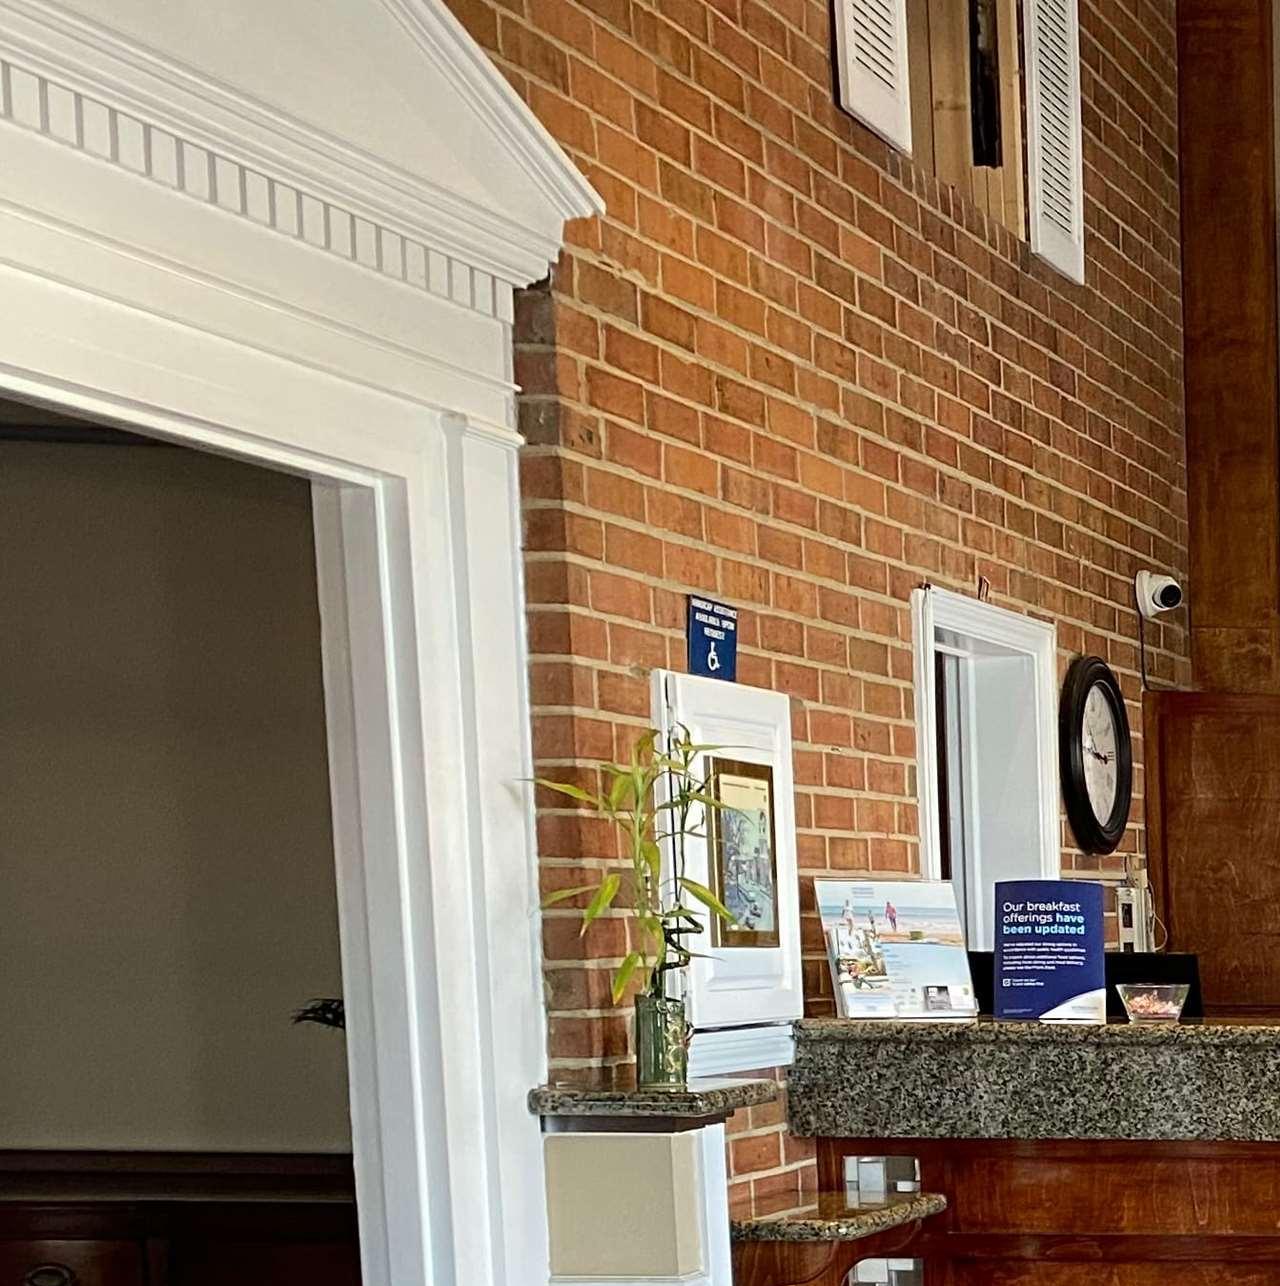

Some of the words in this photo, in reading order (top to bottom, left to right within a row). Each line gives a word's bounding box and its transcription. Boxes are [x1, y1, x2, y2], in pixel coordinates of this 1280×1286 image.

[1003, 902, 1024, 912] Our
[1026, 901, 1081, 912] breakfast
[1003, 913, 1053, 924] offerings
[1055, 912, 1085, 923] have
[1003, 925, 1032, 935] been
[1034, 924, 1086, 936] updated
